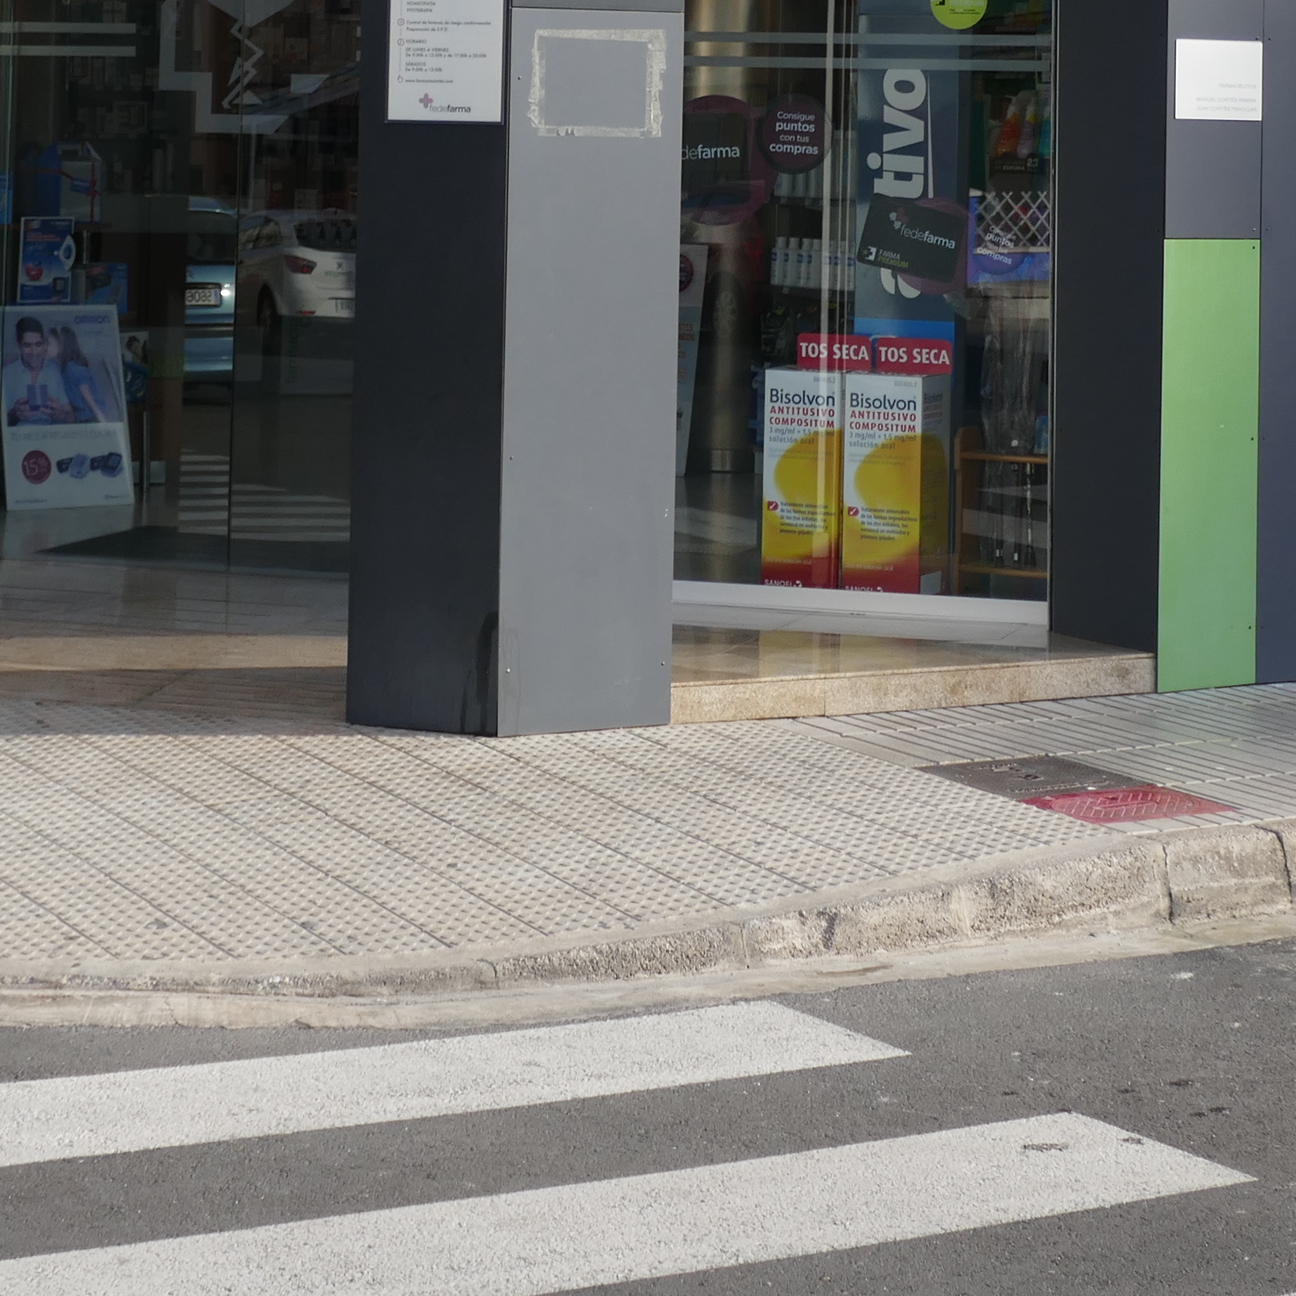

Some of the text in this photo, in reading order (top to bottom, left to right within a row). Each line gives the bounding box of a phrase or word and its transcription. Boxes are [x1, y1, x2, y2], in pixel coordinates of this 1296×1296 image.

[428, 104, 472, 113] fedefarma
[777, 111, 816, 122] Consigue
[775, 122, 816, 133] puntos
[779, 134, 810, 143] con tus
[681, 144, 740, 161] defarma
[769, 143, 819, 156] compras
[900, 224, 956, 249] fedefarma
[985, 232, 1015, 249] puntos
[976, 247, 1013, 266] compras
[800, 342, 869, 361] TOS SECA
[879, 346, 950, 365] TOS SECA
[770, 388, 835, 407] Bisolvon
[850, 392, 917, 411] Bisolvon
[769, 406, 835, 417] ANTITUSIVO
[850, 410, 917, 422] ANTITUSIVO
[769, 417, 835, 428] COMPOSITUM
[849, 421, 916, 433] COMPOSITUM
[774, 427, 796, 435] mg/ml
[854, 432, 876, 440] mg/ml
[894, 435, 917, 443] mg/ml
[849, 440, 896, 450] solución oral
